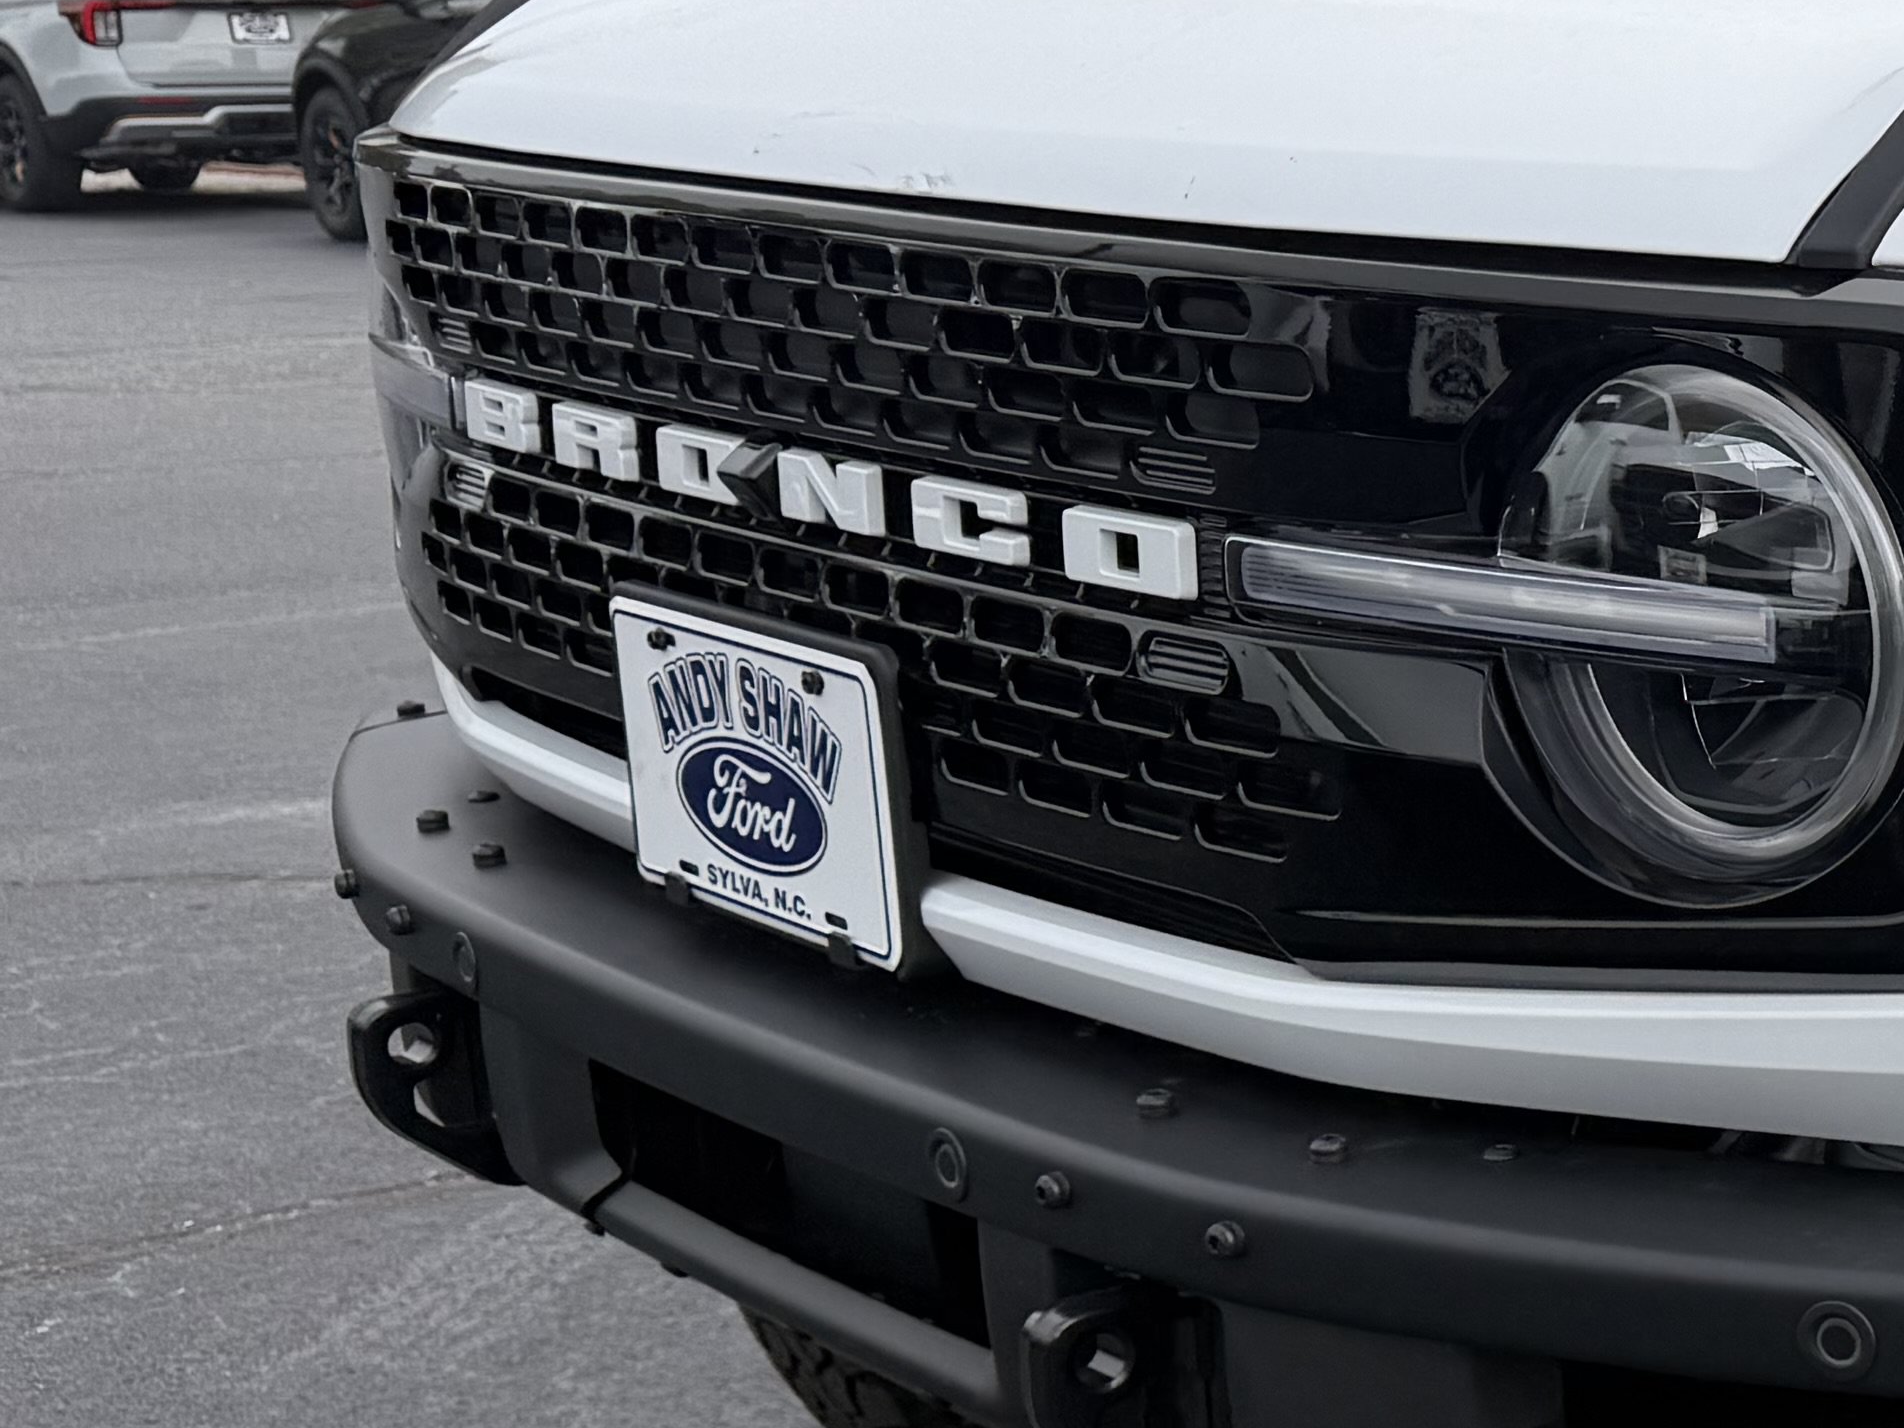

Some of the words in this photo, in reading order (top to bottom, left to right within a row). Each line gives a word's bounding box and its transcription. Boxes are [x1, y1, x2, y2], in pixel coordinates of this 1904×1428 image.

[464, 377, 1200, 601] BRONCO
[648, 652, 734, 753] ANDY
[735, 658, 842, 805] SHAW
[706, 754, 797, 853] Ford
[706, 863, 769, 908] SYLVA,
[773, 886, 812, 920] N.C.
